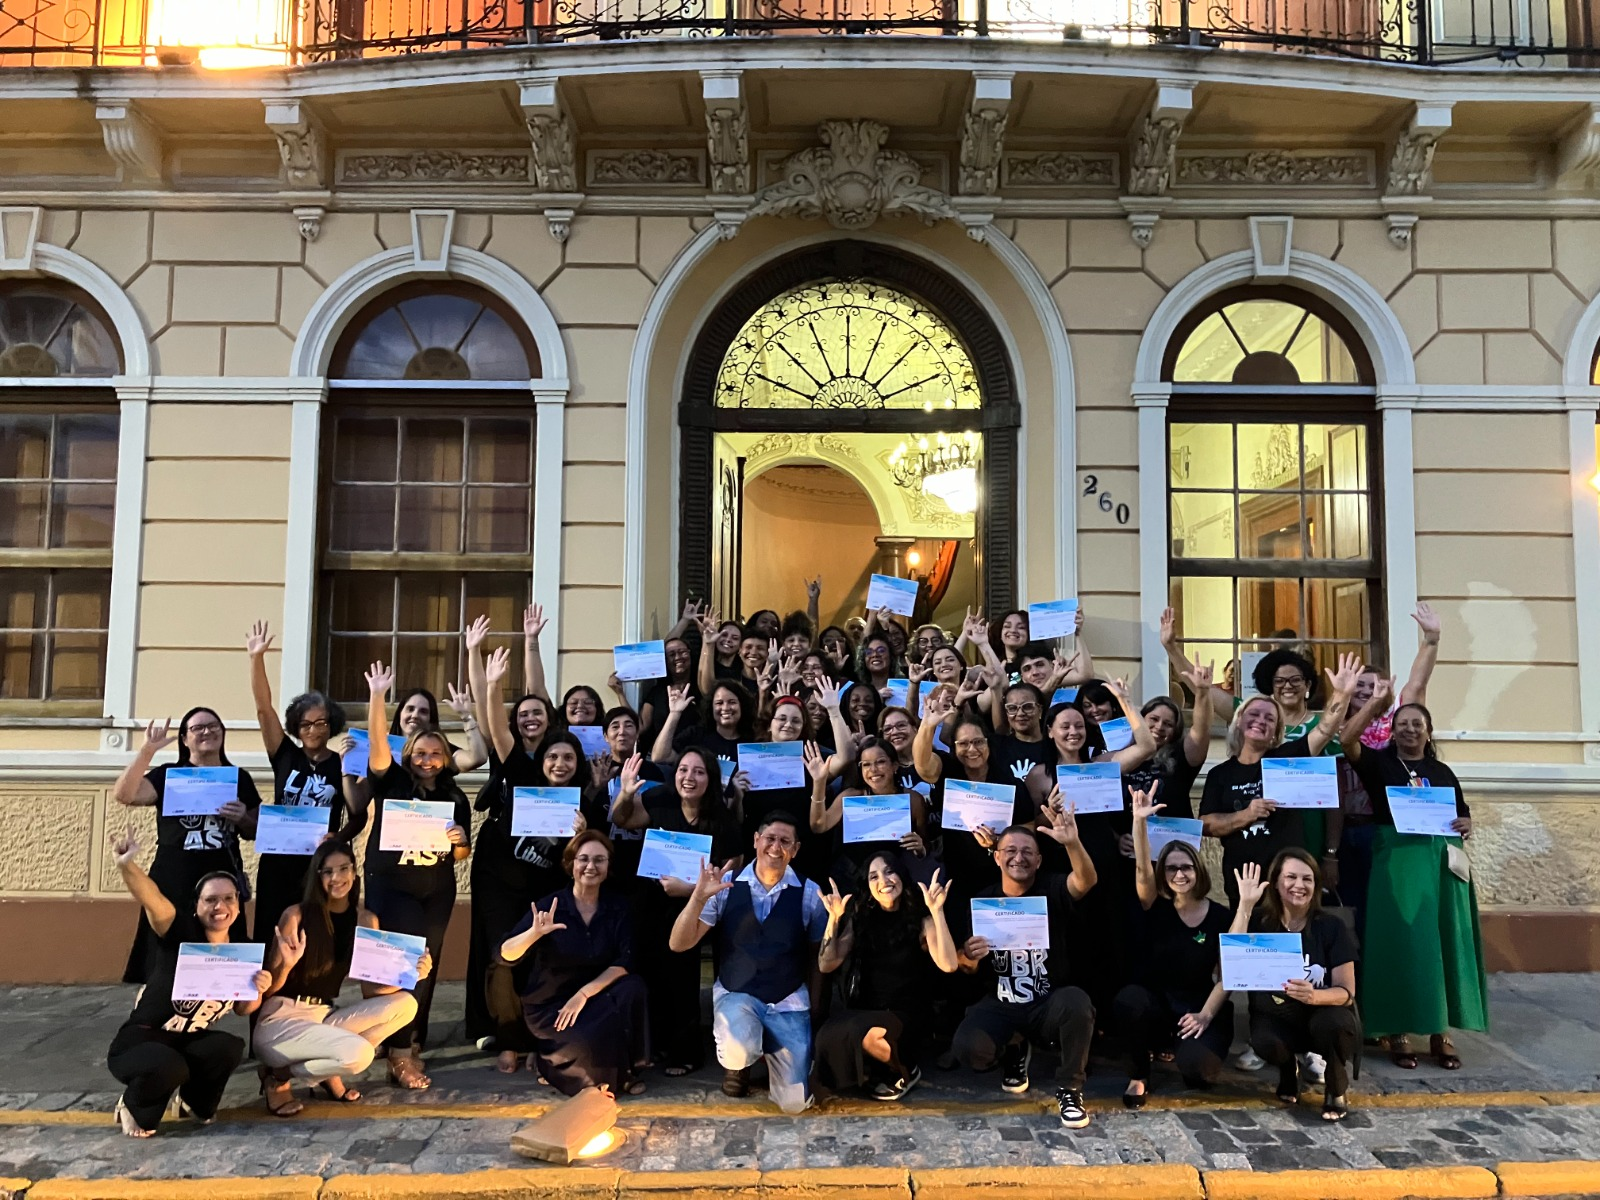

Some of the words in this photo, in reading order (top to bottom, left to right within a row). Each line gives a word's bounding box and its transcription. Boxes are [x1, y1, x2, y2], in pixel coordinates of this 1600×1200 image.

[1083, 474, 1130, 524] 260
[183, 830, 223, 850] AS
[398, 850, 439, 866] AS
[1010, 949, 1048, 976] BR
[997, 976, 1034, 1003] AS
